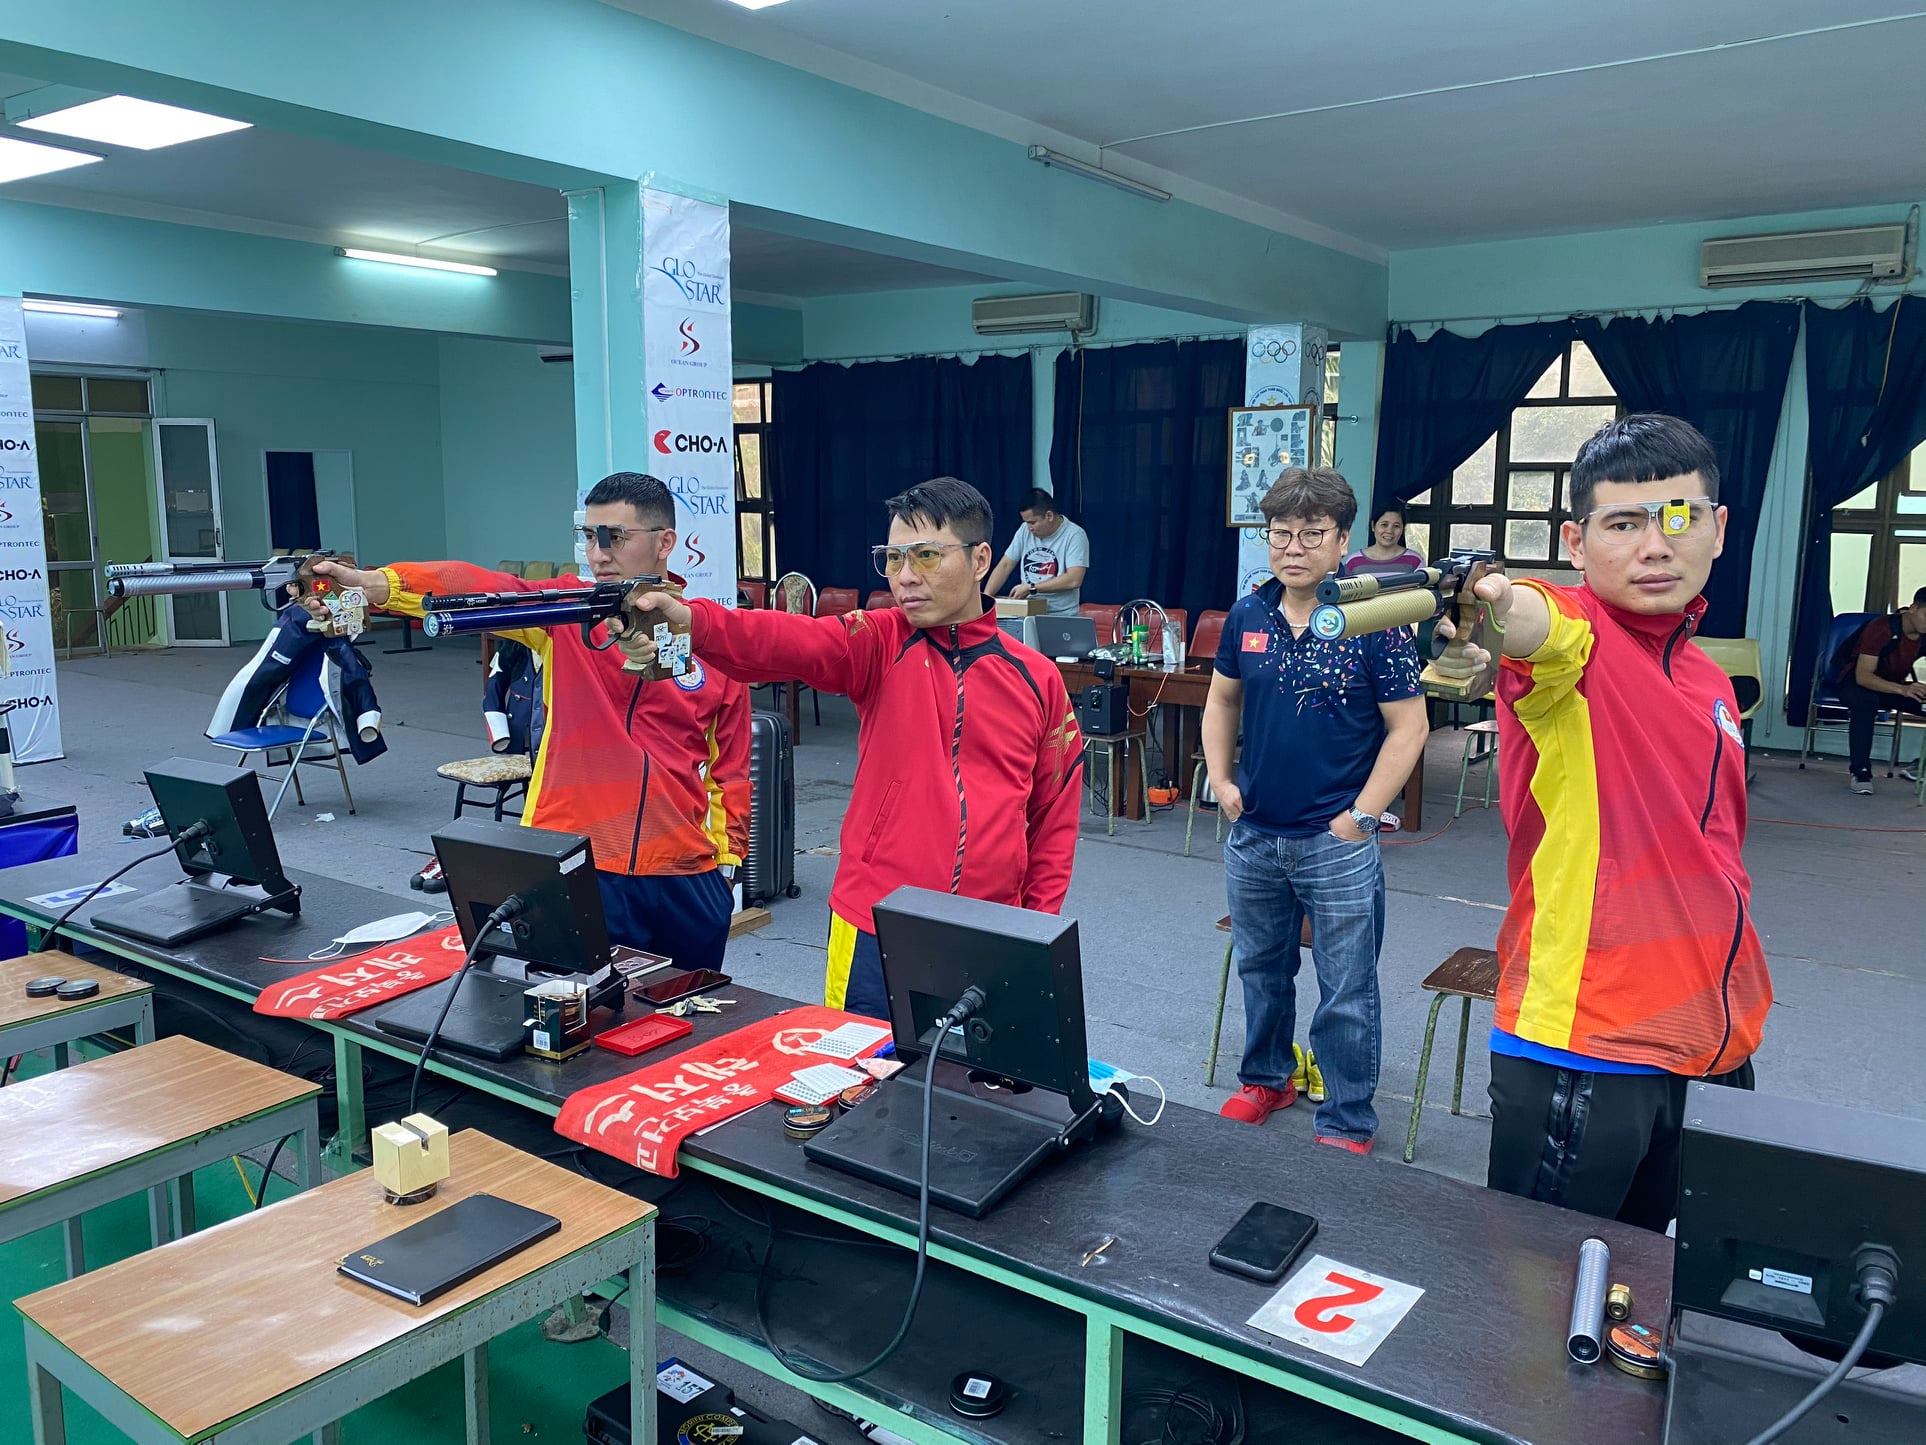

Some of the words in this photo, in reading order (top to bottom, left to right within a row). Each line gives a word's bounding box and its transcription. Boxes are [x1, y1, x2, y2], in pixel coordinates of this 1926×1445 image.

[663, 257, 695, 279] GLO
[686, 280, 724, 305] STAR
[669, 476, 700, 494] GLO
[690, 495, 729, 515] STAR
[8, 605, 45, 619] STAR
[10, 667, 52, 678] PTRONTEC
[1294, 1271, 1385, 1334] 2
[675, 1381, 706, 1397] 157
